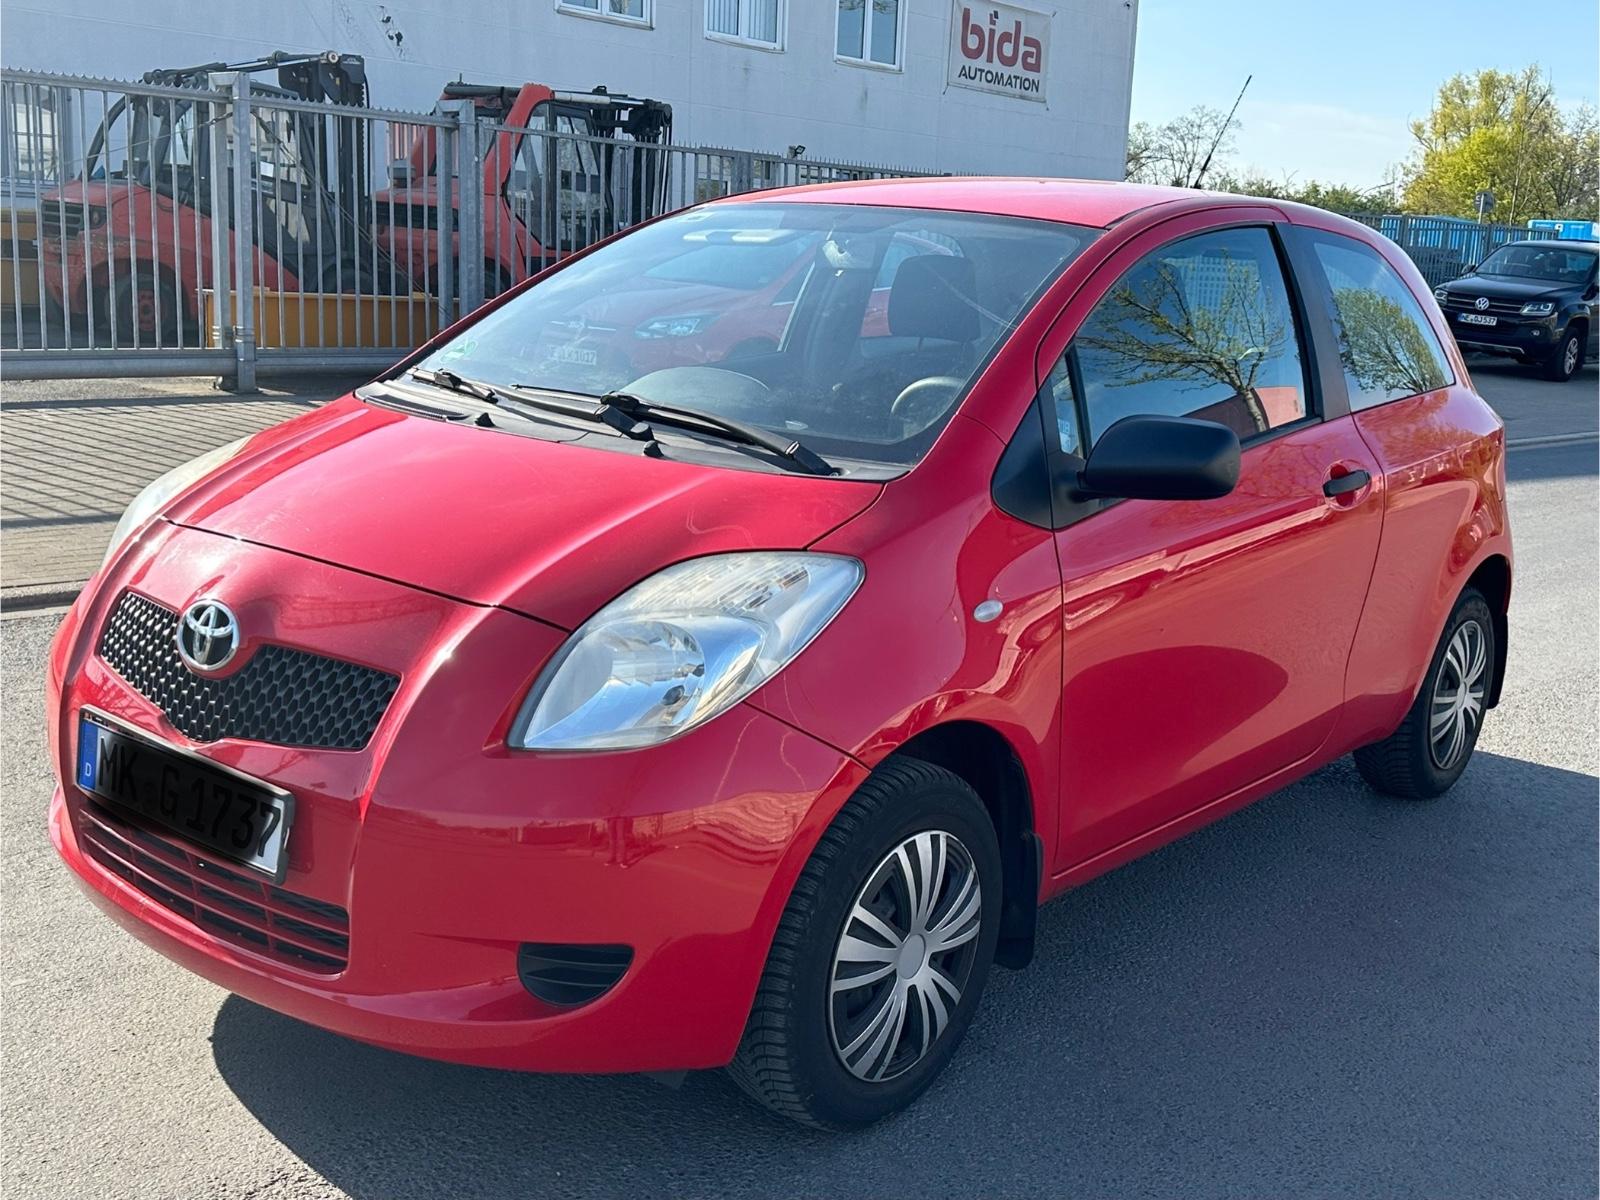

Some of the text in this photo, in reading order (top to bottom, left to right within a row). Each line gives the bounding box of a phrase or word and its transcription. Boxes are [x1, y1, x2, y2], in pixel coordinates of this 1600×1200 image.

[960, 7, 1042, 73] bida
[958, 65, 1040, 93] AUTOMATION
[85, 762, 92, 777] D
[99, 737, 139, 801] MK
[185, 777, 282, 857] 1737
